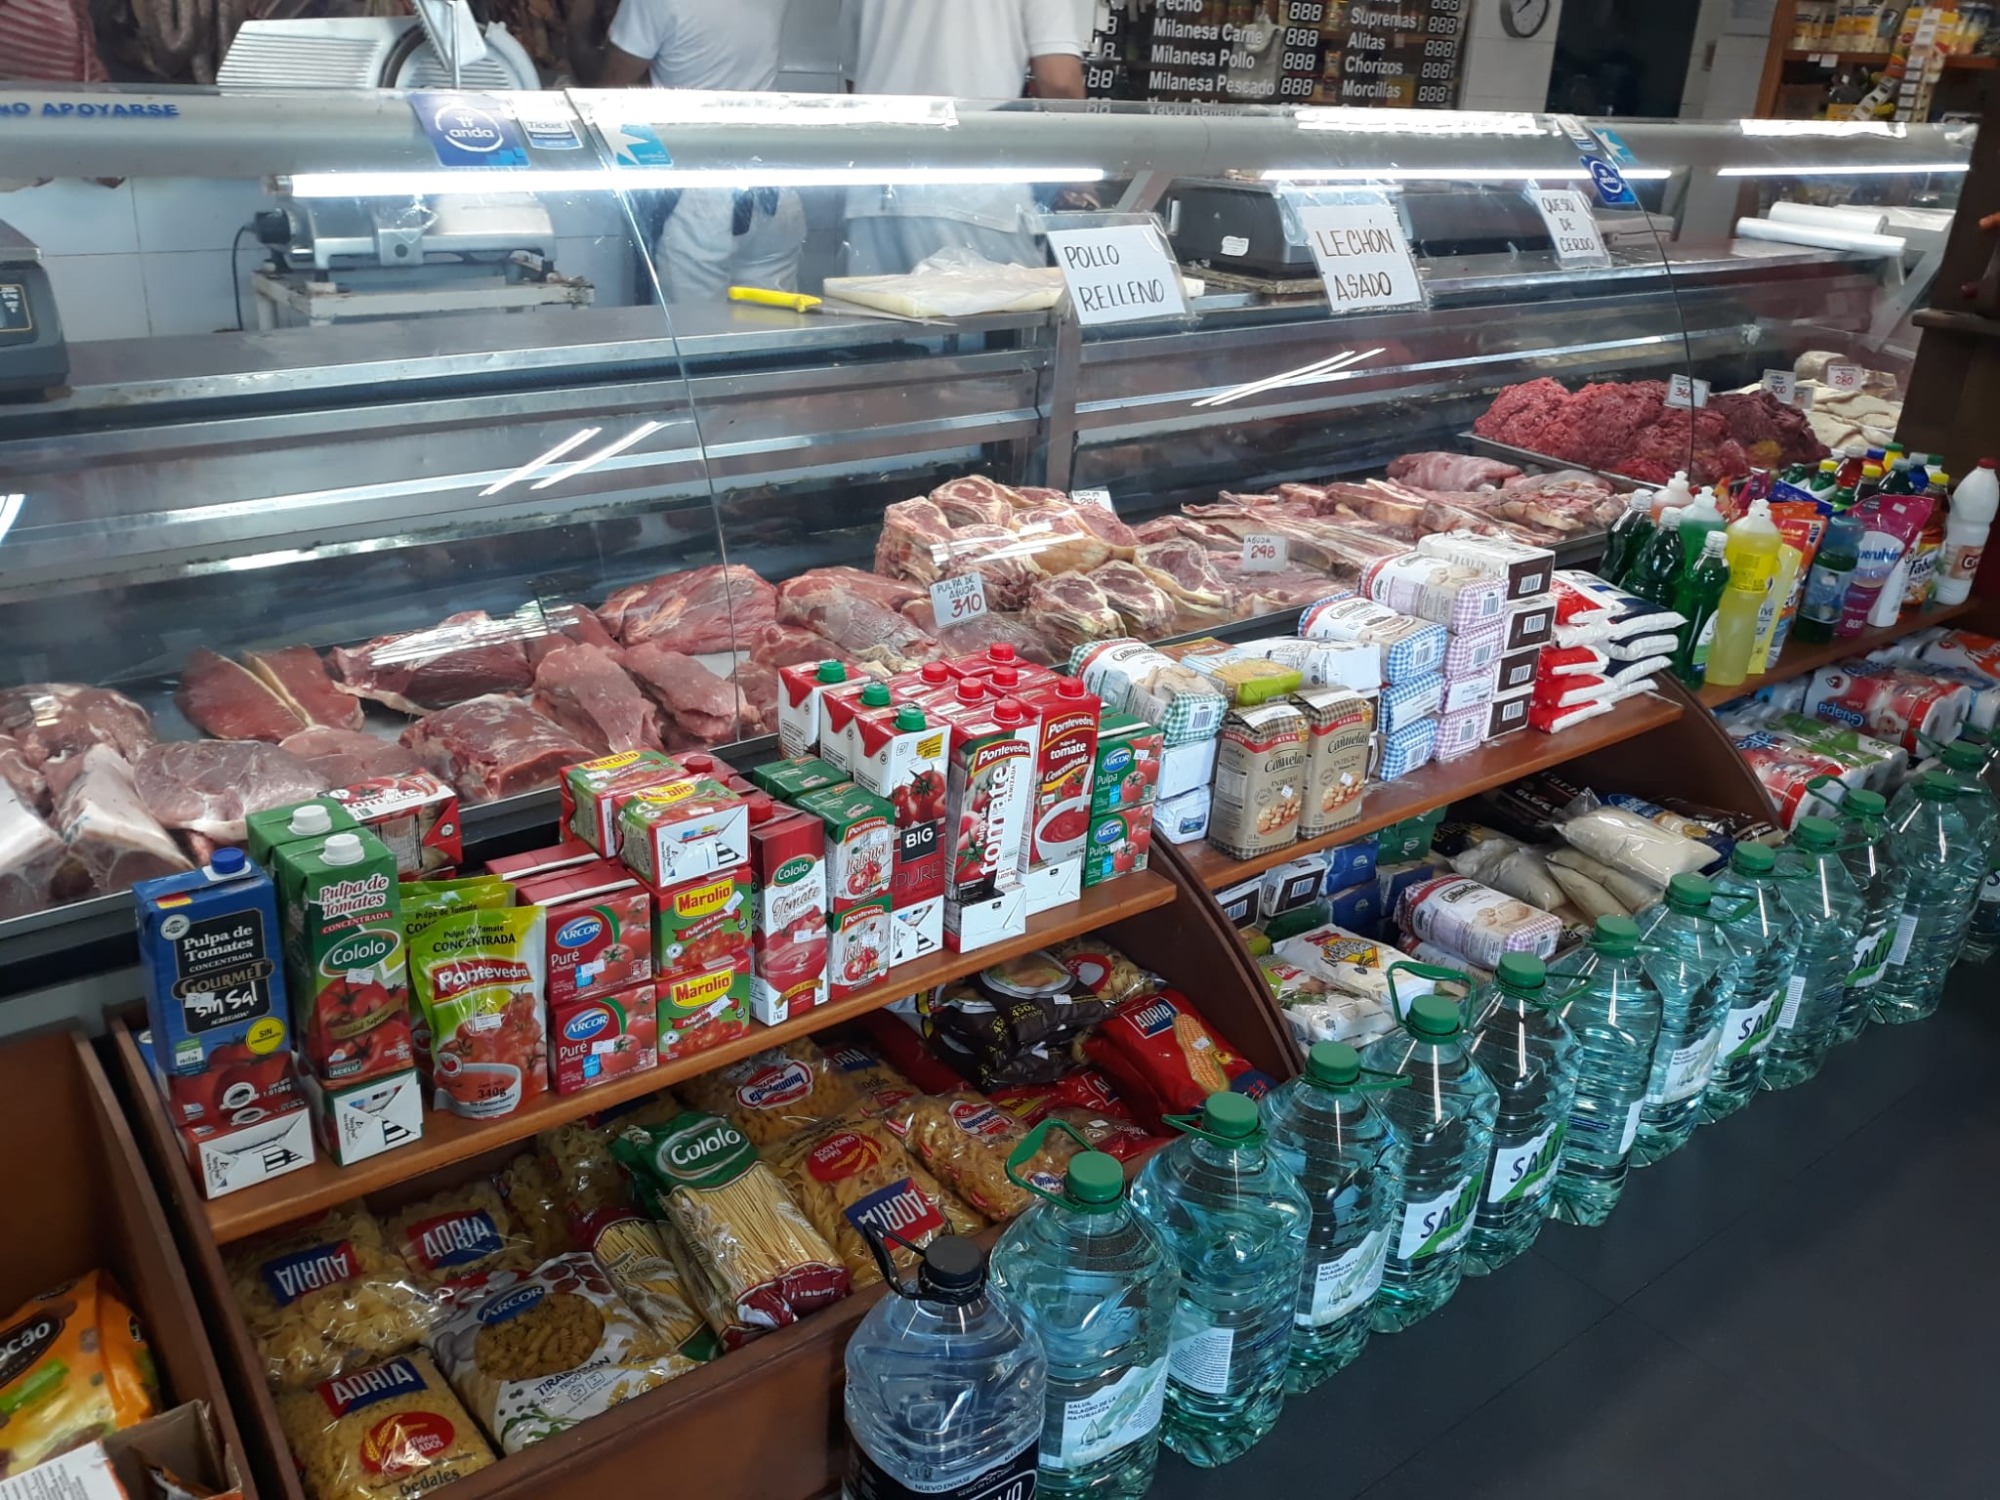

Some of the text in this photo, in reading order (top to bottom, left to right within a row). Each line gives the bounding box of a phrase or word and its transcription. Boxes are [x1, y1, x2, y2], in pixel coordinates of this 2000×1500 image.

[1351, 7, 1417, 28] Supremas
[1153, 17, 1218, 40] Milanesa
[1222, 23, 1263, 44] Carne
[1347, 31, 1387, 50] Alitas
[1151, 44, 1217, 66] Milanesa
[1219, 49, 1255, 68] Pollo
[1345, 53, 1403, 75] Chorizos
[1149, 71, 1213, 92] Milanesa
[1216, 75, 1276, 95] Pescado
[1342, 80, 1401, 99] Morcillas
[43, 102, 179, 119] APOYARSE
[450, 126, 494, 140] anda
[1559, 218, 1576, 231] DE
[1316, 219, 1398, 258] LECHÓN
[1559, 237, 1595, 252] CERDO
[1064, 244, 1121, 269] POLLO
[1078, 278, 1165, 312] RELLENO
[1334, 270, 1393, 302] ASADO
[1250, 545, 1276, 559] 298
[936, 579, 963, 594] PULPA
[951, 593, 982, 618] 310
[1819, 701, 1864, 726] Guapa
[1048, 715, 1095, 739] Pontevedra
[978, 743, 1029, 765] Pontevedra
[1050, 742, 1087, 760] tomate
[1103, 754, 1131, 768] ARCOR
[1007, 764, 1016, 802] TAMIZADA
[1096, 772, 1118, 785] Pulpa
[980, 765, 1010, 877] tomate
[1095, 825, 1121, 839] ARCOR
[905, 827, 934, 849] BIG
[777, 861, 809, 880] Cololo
[895, 862, 941, 887] PURE
[320, 872, 389, 901] Pulpa de
[677, 884, 731, 913] Marolio
[322, 893, 385, 920] Tomates
[322, 911, 390, 933] CONCENTRADA
[557, 923, 600, 942] ARCOR
[183, 926, 253, 950] Pulpa de
[433, 933, 516, 953] CONCENTRADA
[184, 939, 254, 962] Tomates
[188, 952, 254, 973] CONCENTRADA
[332, 939, 386, 966] Cololo
[551, 948, 580, 966] Puré
[180, 961, 265, 996] GOURMET
[438, 965, 529, 992] Pontevedra
[674, 975, 730, 1002] Marolio
[224, 980, 258, 1010] Sal
[565, 1015, 607, 1033] ARCOR
[1134, 1004, 1172, 1029] ADRIA
[258, 1027, 273, 1038] SIN
[559, 1040, 588, 1059] Puré
[671, 1127, 741, 1165] Cololo
[422, 1215, 491, 1260] ADRIA
[274, 1253, 350, 1297] ADRIA
[482, 1287, 544, 1321] ARCOR
[330, 1362, 415, 1406] ADRIA
[399, 1467, 461, 1496] Dedales
[915, 1476, 971, 1492] NUEVO ENVASE
